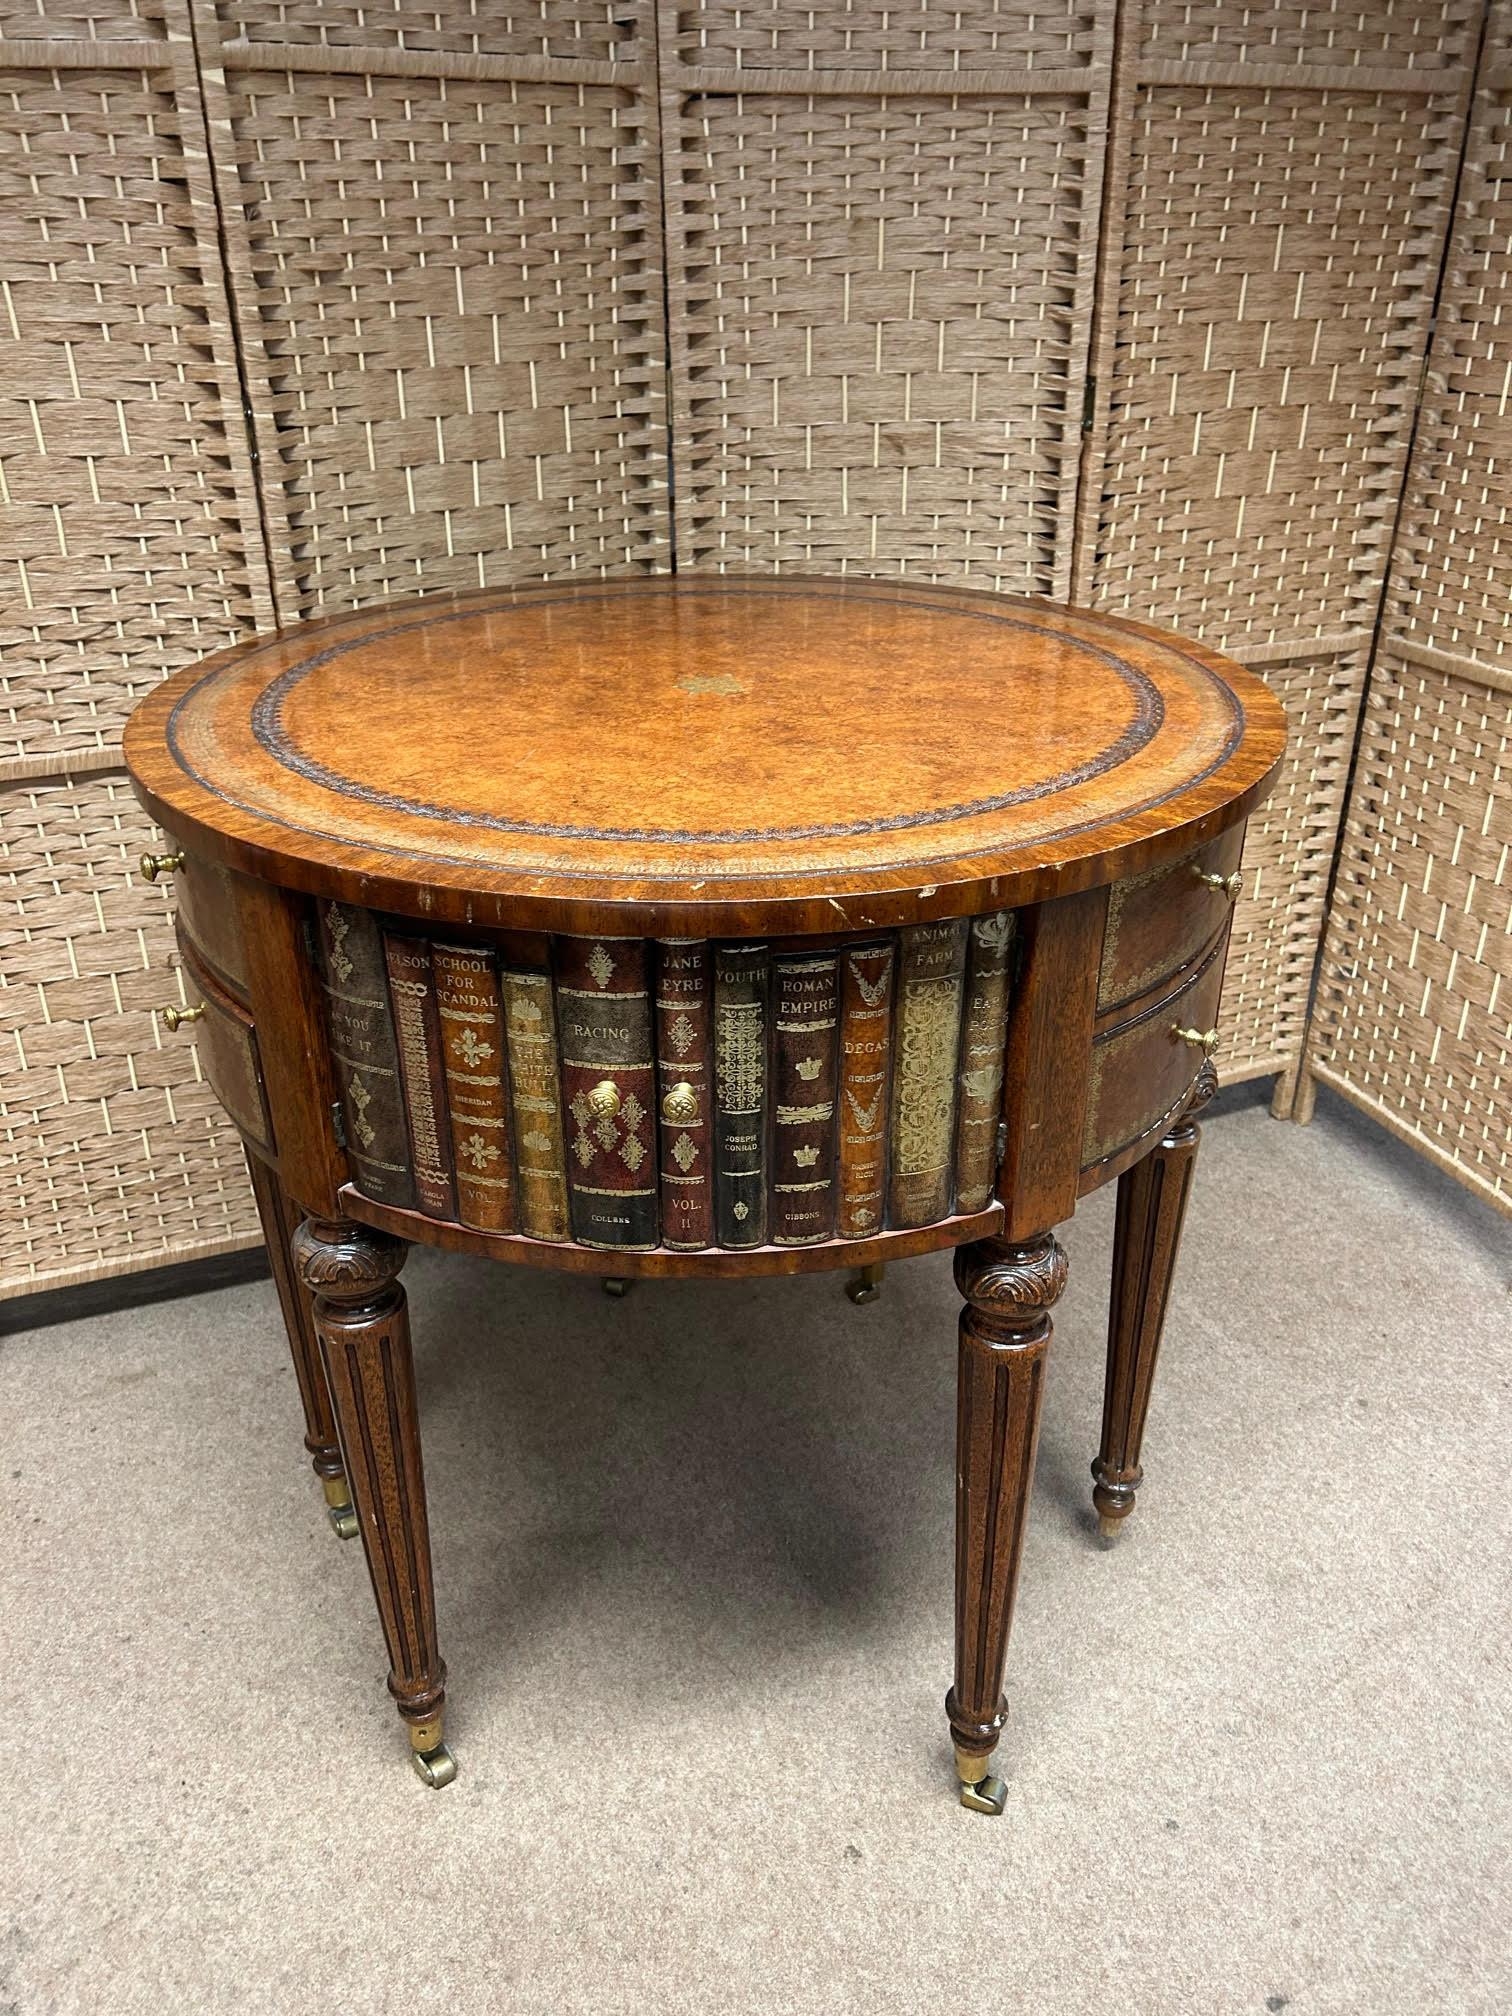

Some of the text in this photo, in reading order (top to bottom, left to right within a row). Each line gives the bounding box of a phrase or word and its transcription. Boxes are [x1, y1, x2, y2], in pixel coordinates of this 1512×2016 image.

[434, 953, 491, 973] SCHOOL
[663, 955, 702, 969] JANE
[916, 951, 954, 966] FARM
[446, 974, 475, 989] FOR
[716, 968, 767, 984] YOUTH
[663, 978, 703, 991] EYRE
[782, 977, 834, 992] ROMAN
[436, 989, 499, 1007] SCANDAL
[781, 997, 837, 1014] EMPIRE
[345, 1015, 369, 1032] YOU
[573, 1024, 630, 1042] RACING
[359, 1040, 372, 1052] IT
[515, 1045, 544, 1060] THE
[844, 1038, 890, 1053] DEGAS
[514, 1076, 551, 1091] BULL
[725, 1134, 757, 1144] JOSEPH
[724, 1143, 758, 1152] CONRAD
[672, 1199, 702, 1210] VOL.
[785, 1211, 820, 1221] GIBBONS
